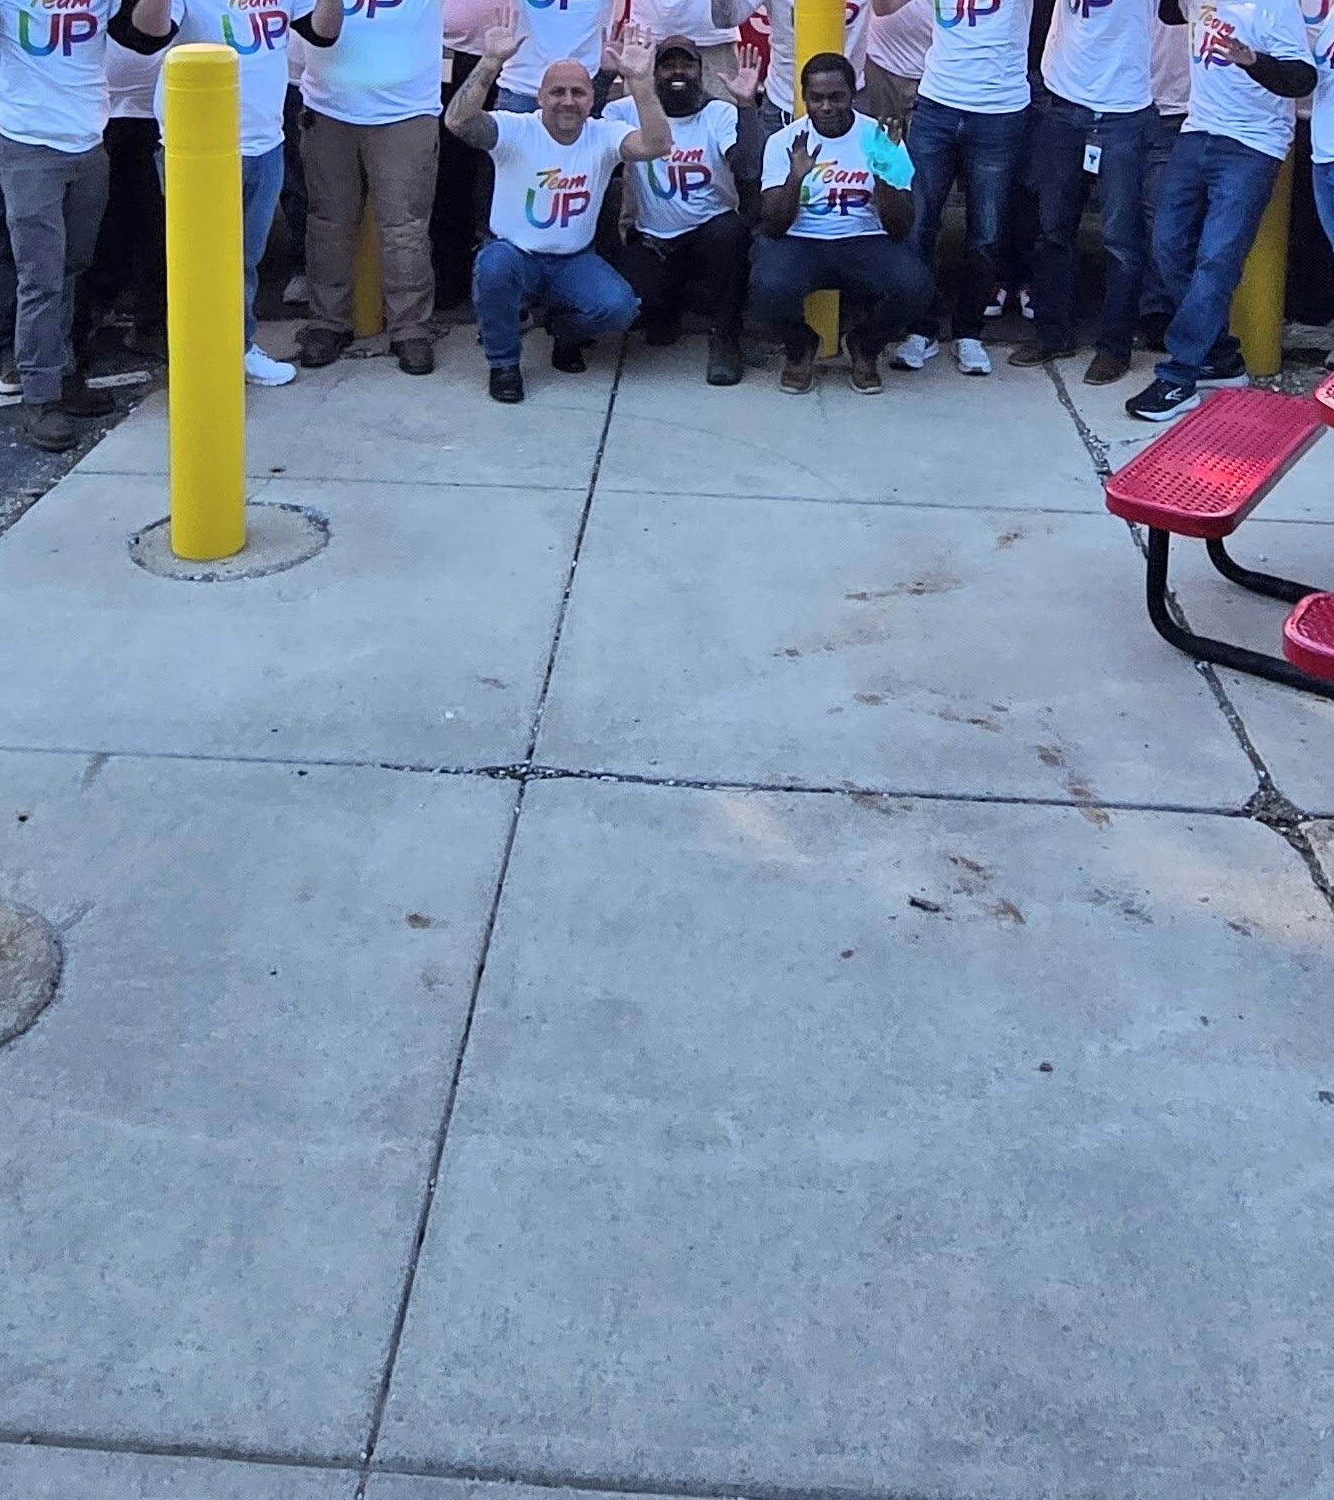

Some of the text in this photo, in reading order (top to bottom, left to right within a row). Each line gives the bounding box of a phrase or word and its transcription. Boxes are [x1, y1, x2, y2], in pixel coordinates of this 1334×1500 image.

[18, 9, 99, 57] UP
[221, 10, 288, 56] UP
[535, 167, 588, 190] Team
[647, 158, 712, 201] UP
[811, 160, 870, 185] Team
[523, 189, 592, 230] UP
[800, 182, 874, 217] UP
